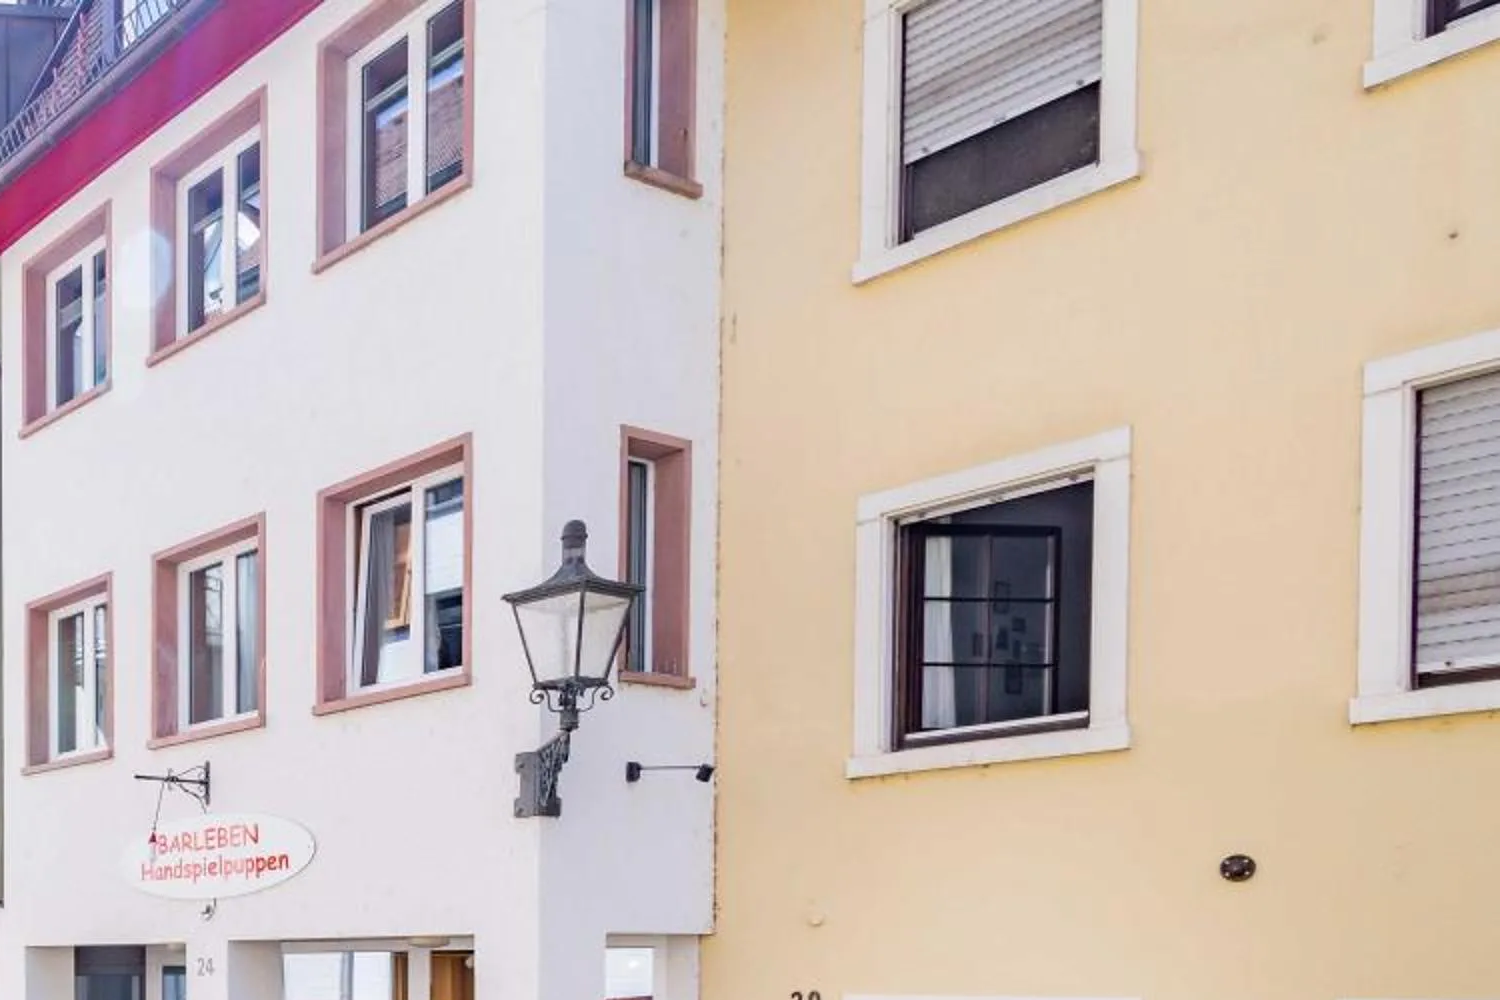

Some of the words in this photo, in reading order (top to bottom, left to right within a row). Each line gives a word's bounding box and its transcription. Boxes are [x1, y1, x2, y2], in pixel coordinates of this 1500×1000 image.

[156, 824, 260, 855] BARLEBEN
[141, 853, 289, 883] Handspielpuppen
[196, 957, 216, 977] 24
